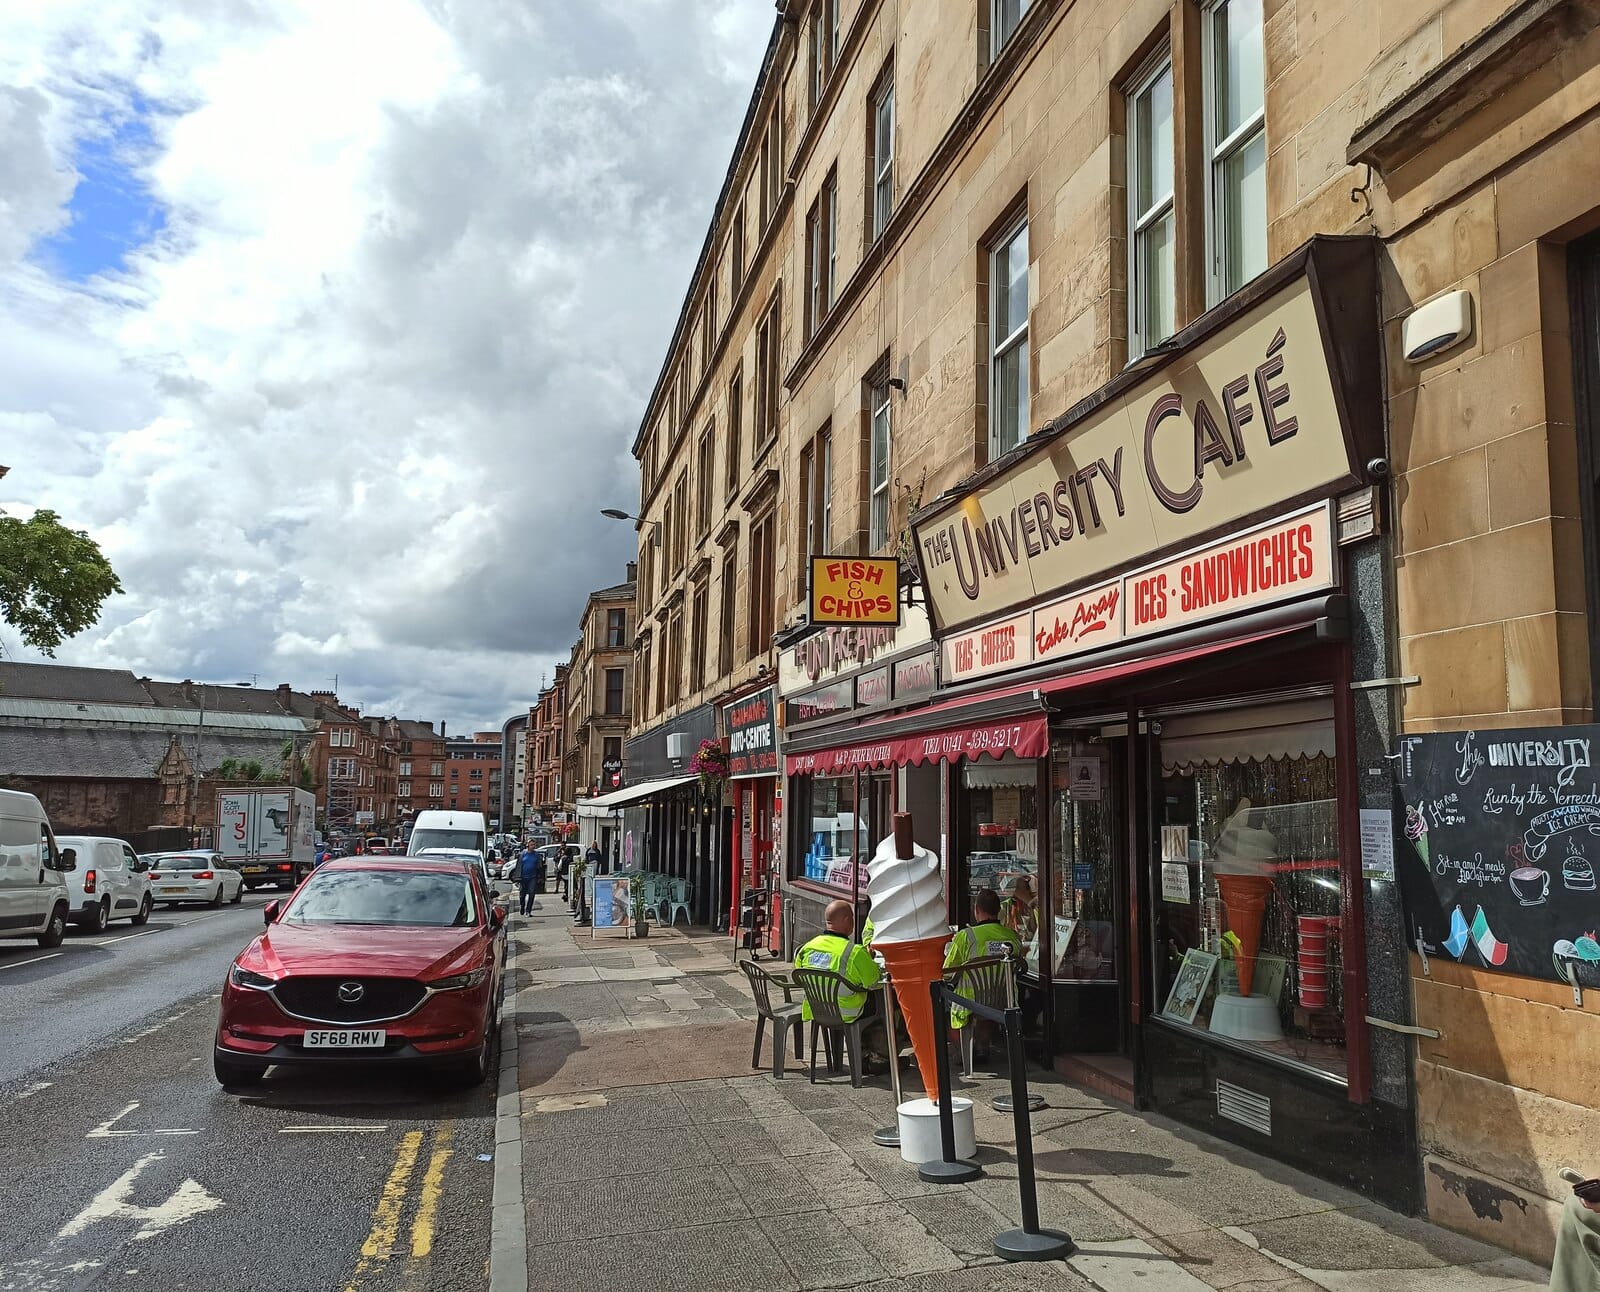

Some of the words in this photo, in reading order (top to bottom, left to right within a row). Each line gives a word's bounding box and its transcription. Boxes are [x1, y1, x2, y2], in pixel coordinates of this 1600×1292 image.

[924, 529, 951, 568] THE
[949, 446, 1125, 600] UNIVERSITY
[1143, 326, 1299, 514] CAFÉ
[826, 561, 884, 586] FISH
[1134, 573, 1168, 626] ICES
[1181, 524, 1313, 612] SANDWICHES
[847, 580, 864, 600] &
[819, 595, 892, 618] CHIPS
[1036, 617, 1069, 654] take
[1069, 587, 1120, 638] Away
[955, 638, 973, 673] TEAS
[981, 625, 1015, 667] COFFEES
[858, 674, 886, 701] PIZZAS
[898, 662, 931, 690] PASTAS
[730, 723, 771, 753] AUTO-CENTRE
[923, 737, 939, 755] TEL
[942, 734, 962, 752] 0141
[1455, 730, 1486, 785] The
[1487, 738, 1591, 785] UNIVERSITY
[1483, 788, 1510, 814] Run
[1509, 783, 1526, 816] by
[1526, 783, 1549, 805] the
[1548, 782, 1600, 806] Verrecch
[1551, 805, 1580, 819] AWARD
[1546, 819, 1563, 834] ICE
[1563, 813, 1589, 827] CREAM
[1164, 829, 1186, 857] IN
[1474, 852, 1484, 870] 2
[1484, 860, 1506, 875] meals
[310, 1031, 348, 1045] SF68
[351, 1031, 380, 1045] RMV
